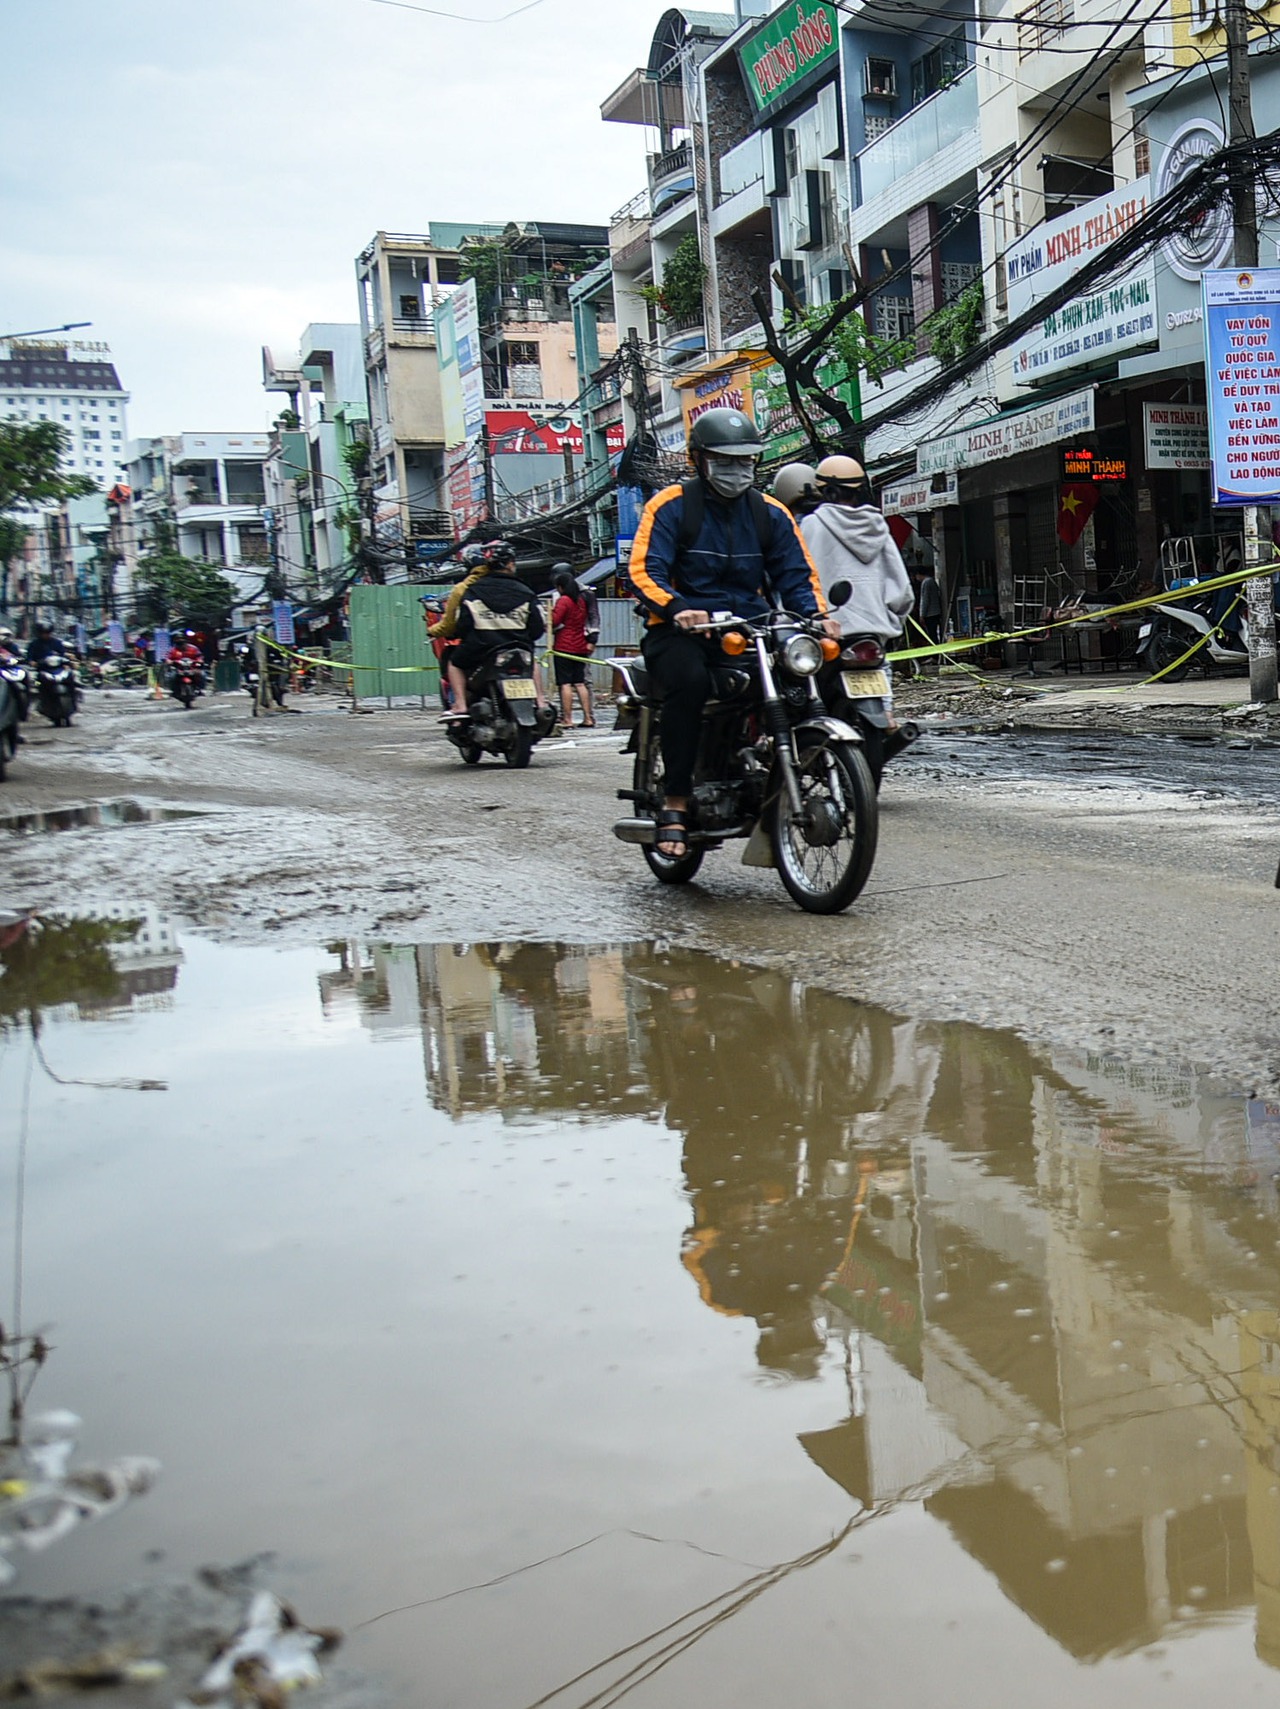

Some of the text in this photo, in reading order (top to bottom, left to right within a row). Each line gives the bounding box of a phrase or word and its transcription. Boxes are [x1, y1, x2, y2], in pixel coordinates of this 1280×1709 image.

[753, 4, 832, 97] PHÙNG NỒNG
[1008, 254, 1020, 281] MỸ
[1043, 314, 1058, 339] SPA
[1062, 304, 1083, 333] PHUN
[1130, 278, 1150, 308] NAIL
[1227, 314, 1270, 330] VAY VỐN
[1230, 333, 1268, 347] TỪ QUỸ
[1225, 350, 1275, 364] QUỐC GIA
[1218, 367, 1231, 380] VỀ
[1234, 367, 1258, 382] VIỆC
[1223, 383, 1280, 397] ĐỂ DUY TRÌ
[492, 402, 512, 410] NHÀ
[516, 402, 542, 410] PHÂN
[1234, 401, 1271, 414] VÀ TẠO
[1150, 410, 1169, 423] MINH
[1170, 408, 1196, 424] THÀNH
[1228, 416, 1278, 431] VIỆC LÀM
[968, 430, 1003, 453] MINH
[1005, 411, 1056, 444] THÀNH
[1227, 433, 1280, 446] BỀN VỮNG
[1065, 456, 1126, 474] MINH THÀNH
[1226, 452, 1248, 463] CHO
[1230, 468, 1250, 480] LAO
